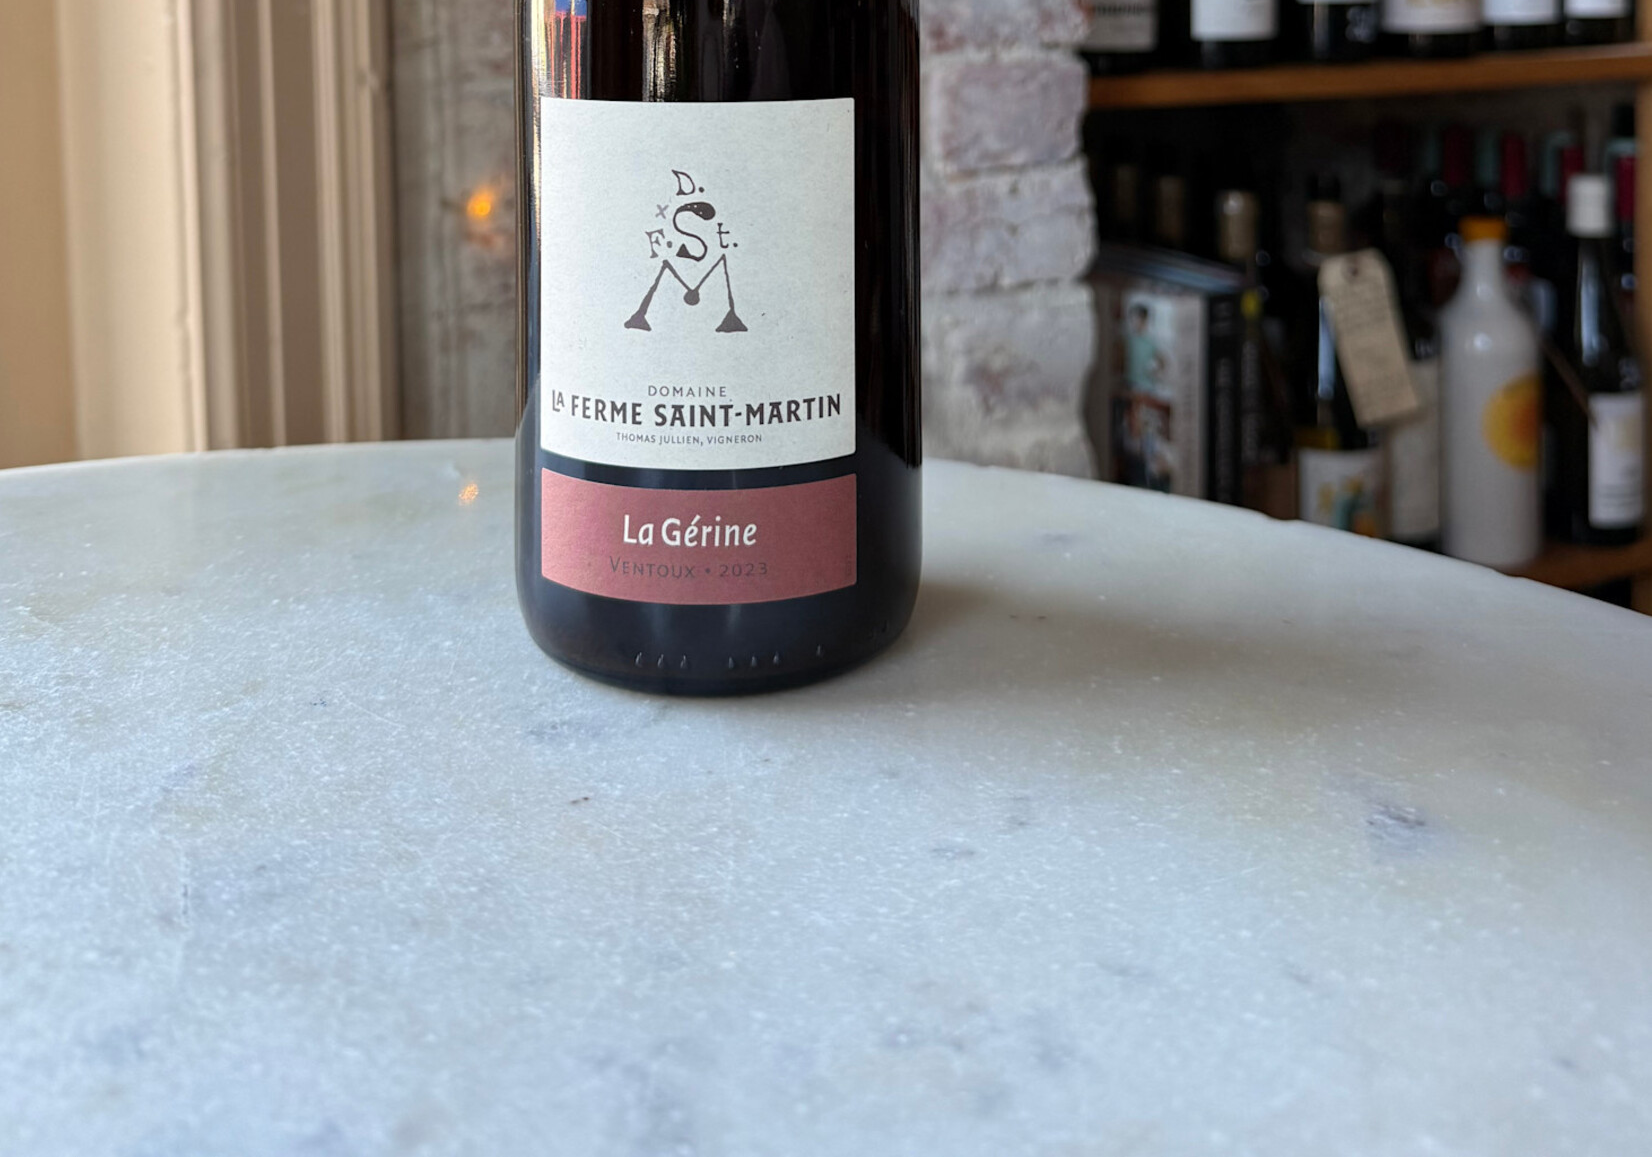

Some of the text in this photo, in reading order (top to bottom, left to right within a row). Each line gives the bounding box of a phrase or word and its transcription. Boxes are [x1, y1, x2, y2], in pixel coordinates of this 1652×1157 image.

[647, 385, 728, 398] DOMAINE
[571, 394, 643, 426] FERME
[654, 392, 842, 428] SAINT-MARTIN
[616, 431, 763, 447] THOMAS JULLIEN, VIGNERON
[623, 514, 758, 547] La Gérine
[719, 561, 769, 578] 2023
